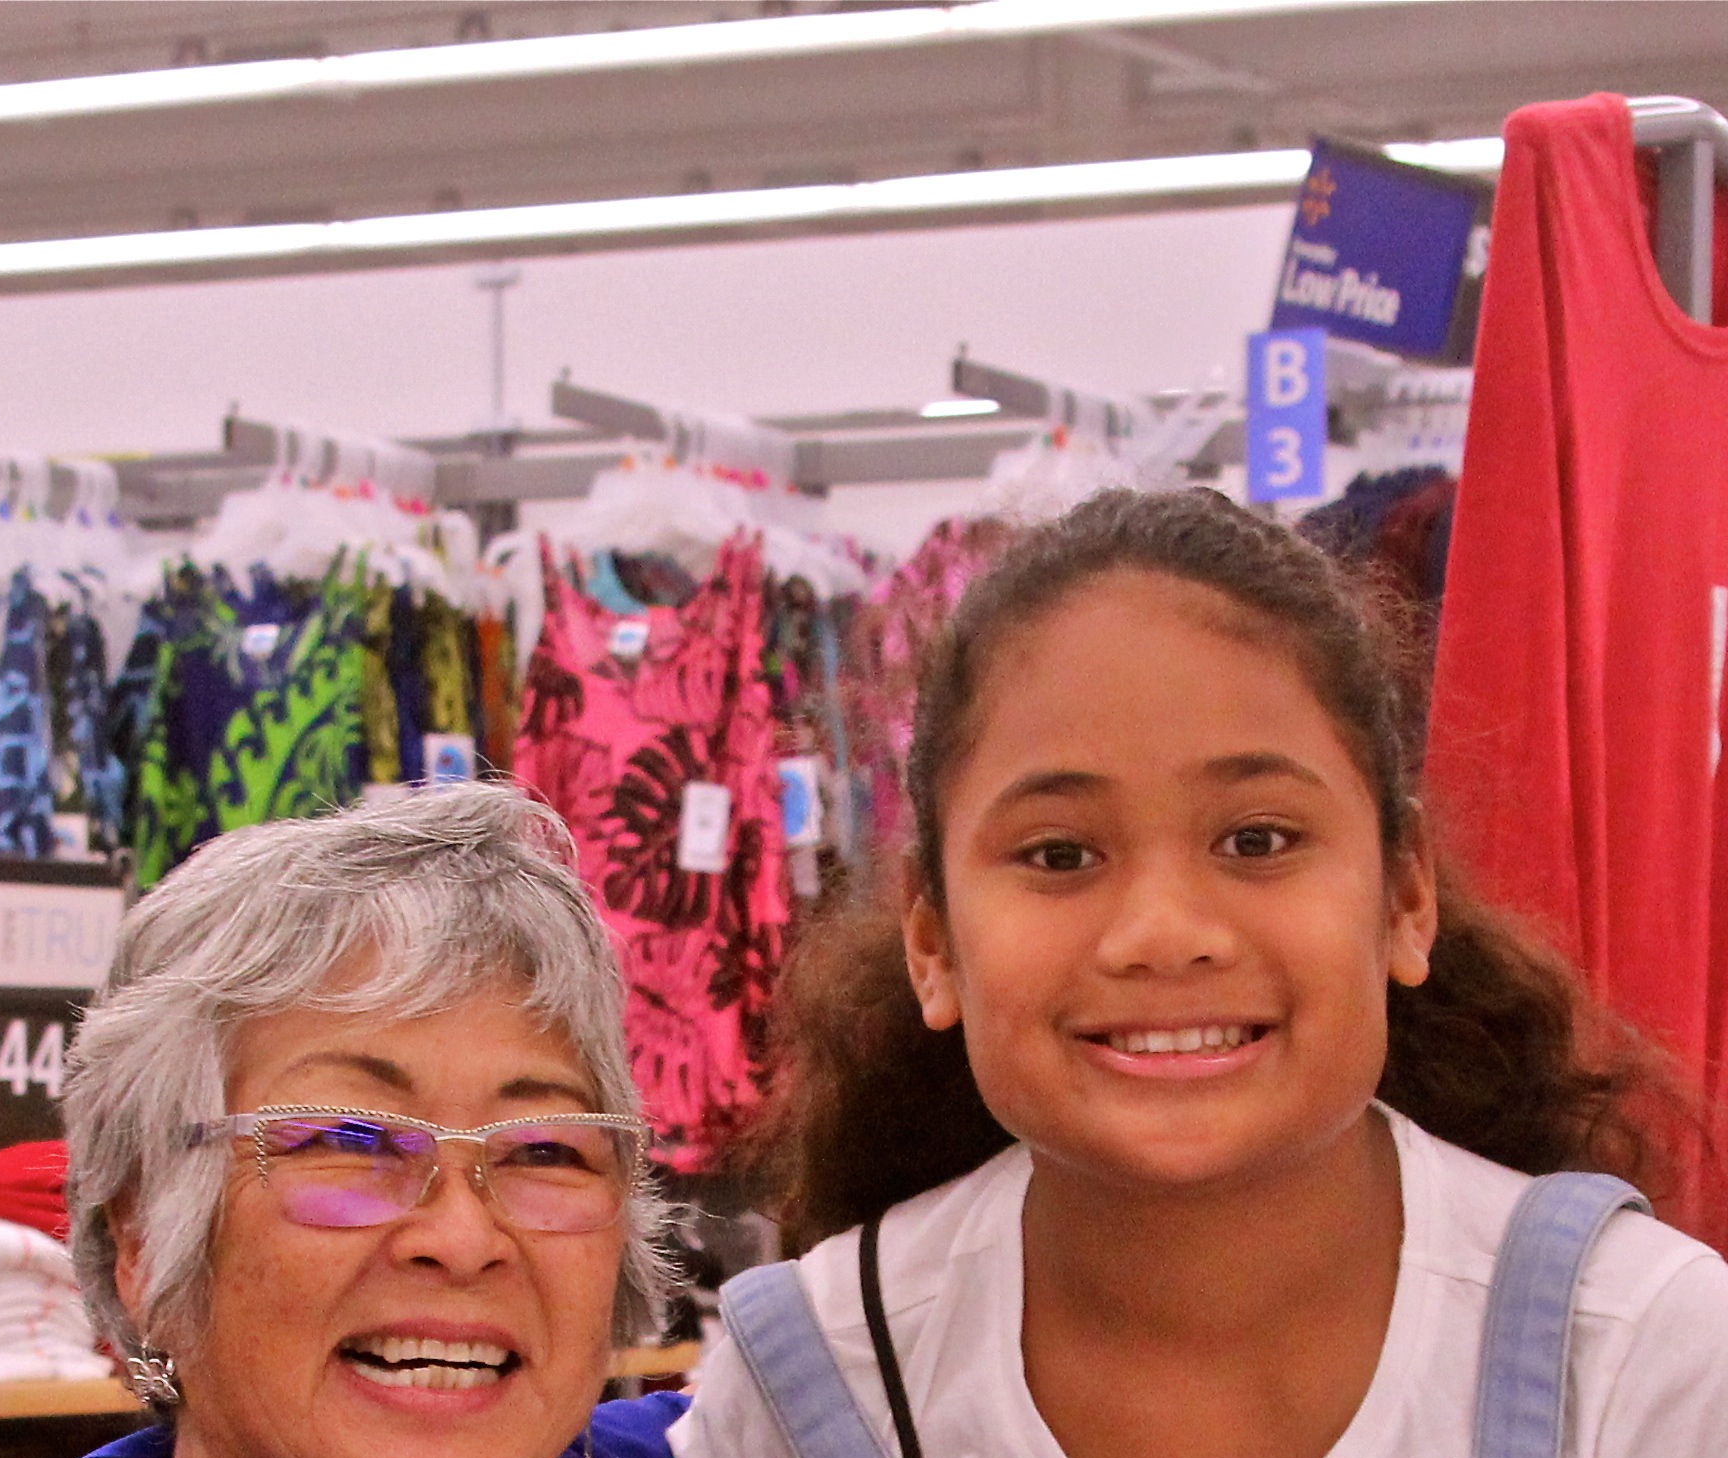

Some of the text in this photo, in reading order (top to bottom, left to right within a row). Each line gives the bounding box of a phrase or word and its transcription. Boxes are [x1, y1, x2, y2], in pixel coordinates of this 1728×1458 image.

[1281, 245, 1336, 310] Low
[1334, 267, 1401, 326] Price
[1263, 338, 1310, 406] B
[1266, 426, 1305, 487] 3
